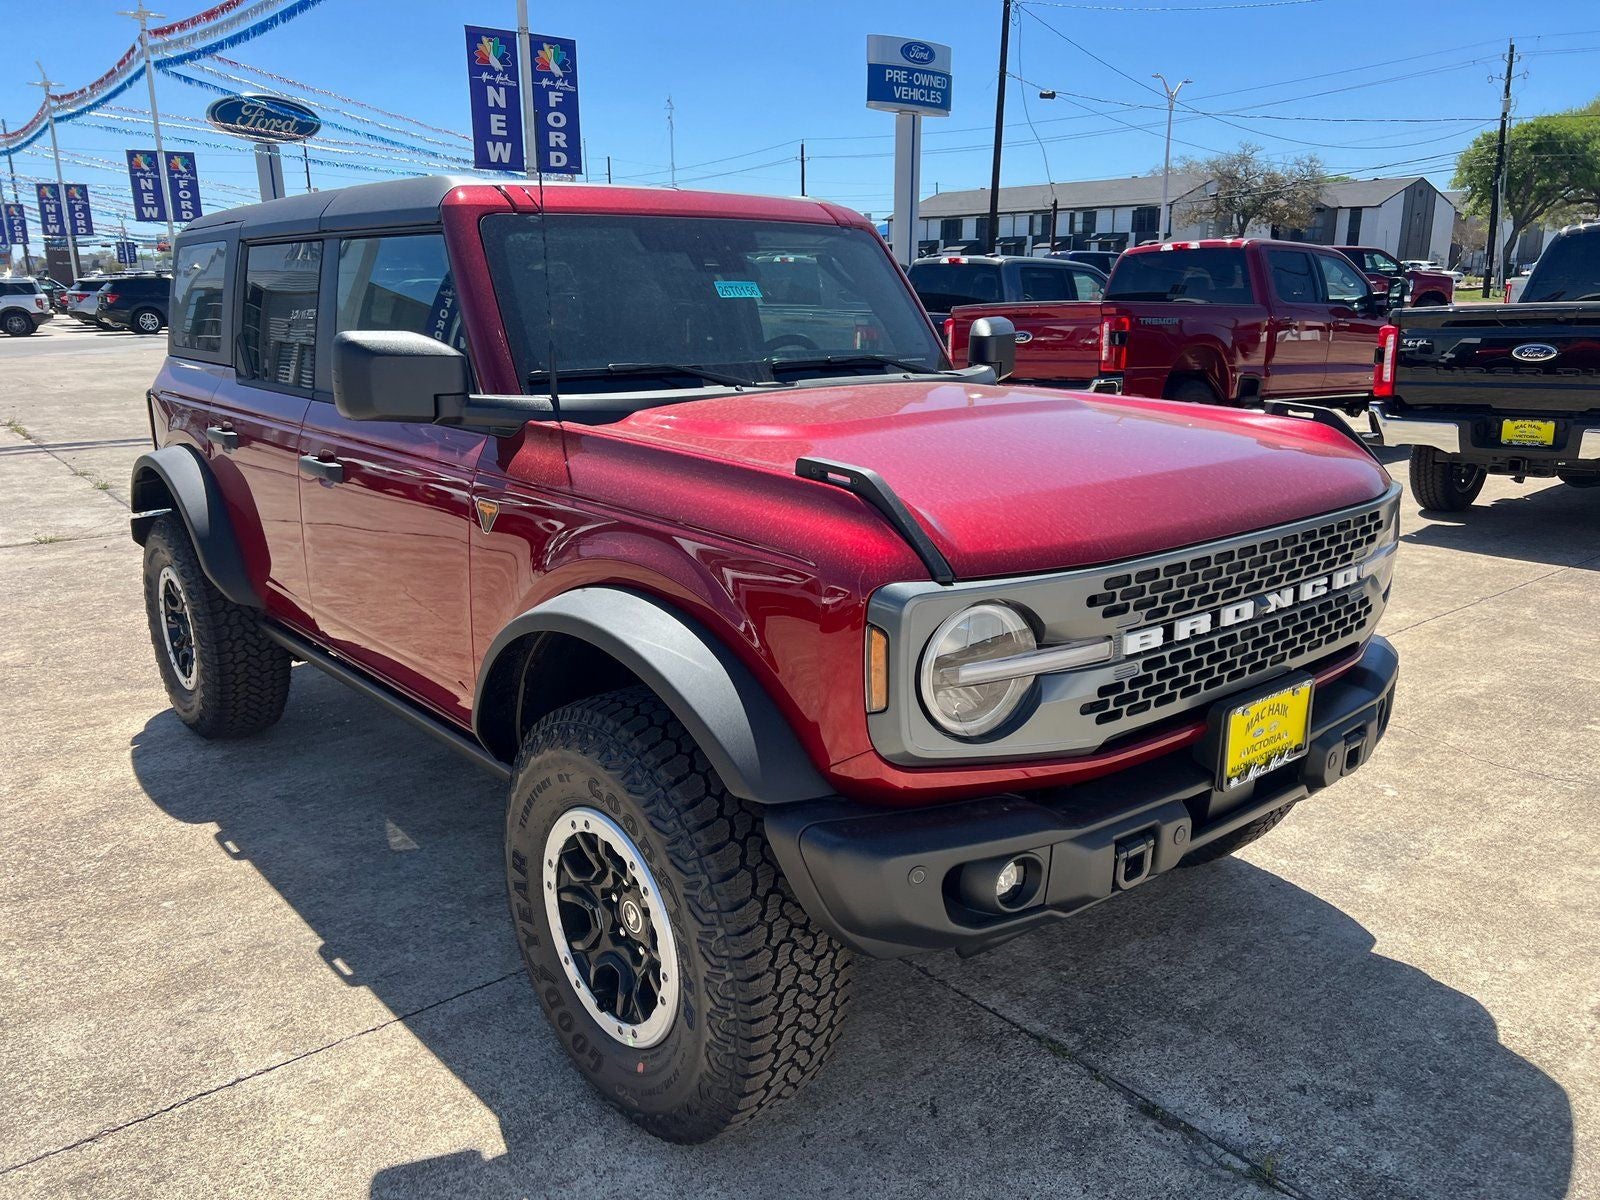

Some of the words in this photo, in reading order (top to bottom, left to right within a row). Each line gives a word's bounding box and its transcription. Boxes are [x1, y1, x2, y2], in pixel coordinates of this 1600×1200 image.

[909, 45, 929, 60] Ford
[885, 69, 948, 89] PRE-OWNED
[893, 86, 942, 104] VEHICLES
[236, 103, 299, 133] Ford
[486, 86, 512, 164] NEW
[546, 91, 568, 167] FORD
[139, 178, 159, 219] NEW
[178, 179, 194, 220] FORD
[13, 219, 24, 243] FORD
[45, 203, 60, 234] NEW
[74, 204, 87, 234] FORD
[1139, 317, 1180, 326] TREMOR
[1520, 347, 1546, 358] Ford
[1122, 566, 1359, 656] BRONCO
[1245, 706, 1267, 735] MAC
[1267, 702, 1289, 718] HAIK
[1245, 733, 1282, 756] VICTORIA
[1246, 763, 1268, 781] Mac
[518, 776, 553, 828] TERRITORY
[511, 848, 604, 1073] GOODYEAR
